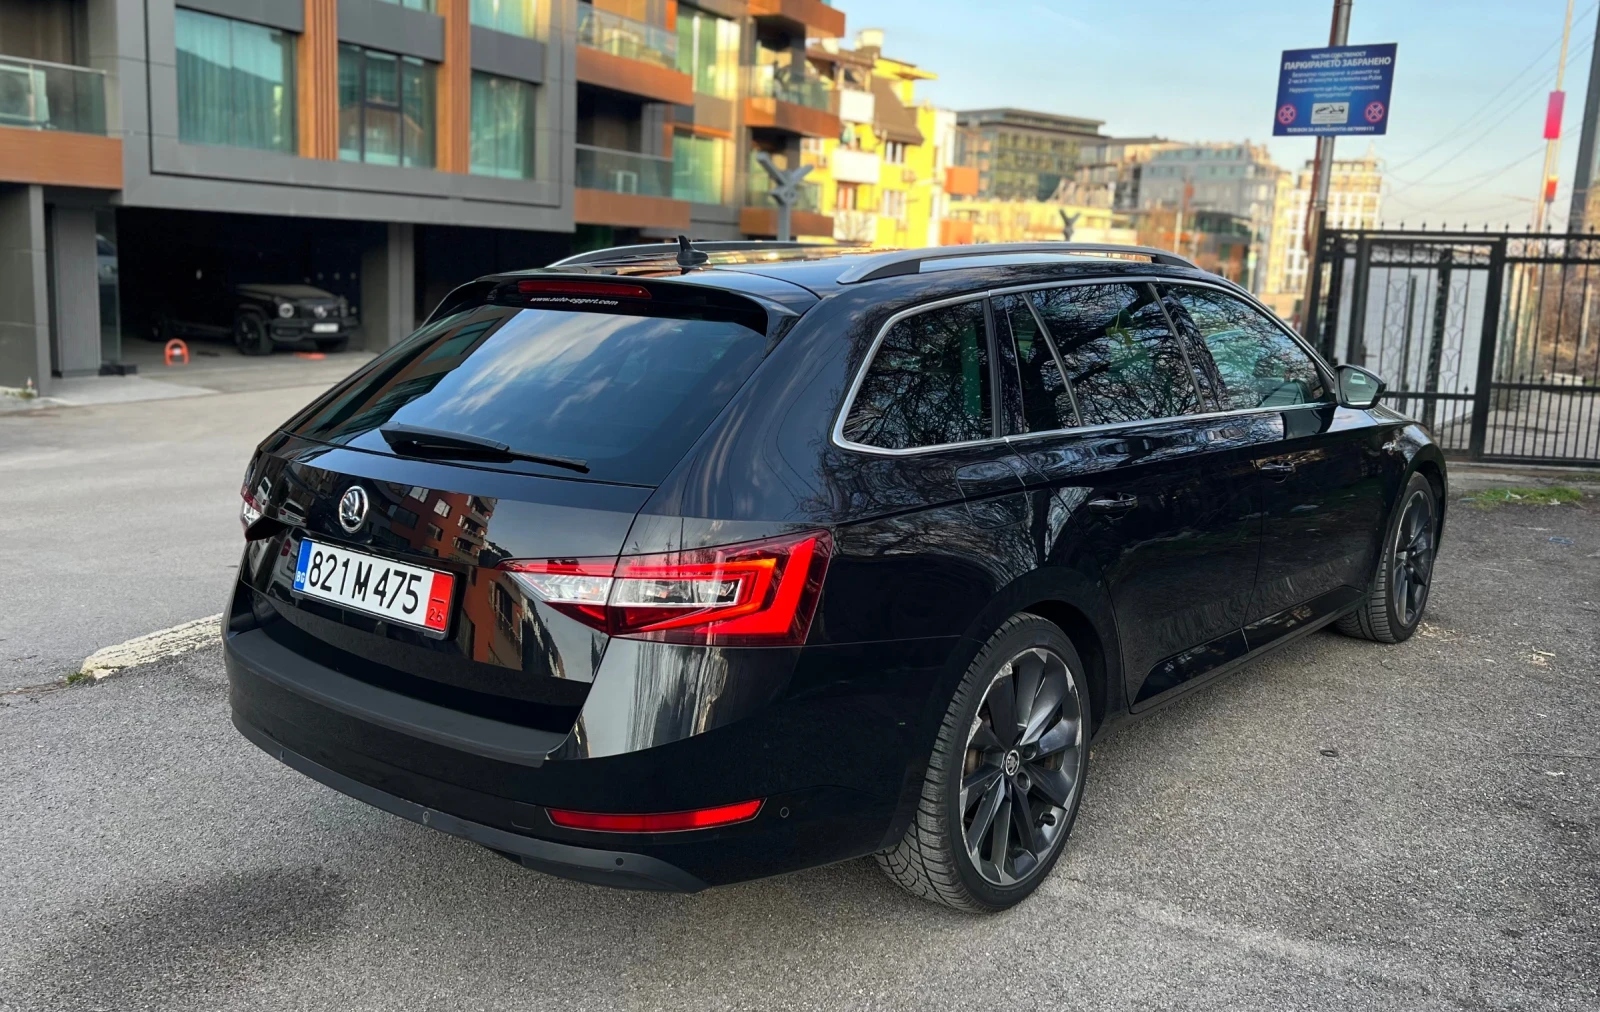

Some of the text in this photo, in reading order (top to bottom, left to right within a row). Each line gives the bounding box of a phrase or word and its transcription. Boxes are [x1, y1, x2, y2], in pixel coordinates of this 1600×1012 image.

[1284, 56, 1392, 70] ПАРКИРАНЕТО ЗАБРАНЕНО
[295, 570, 306, 584] BG
[429, 608, 444, 623] 26
